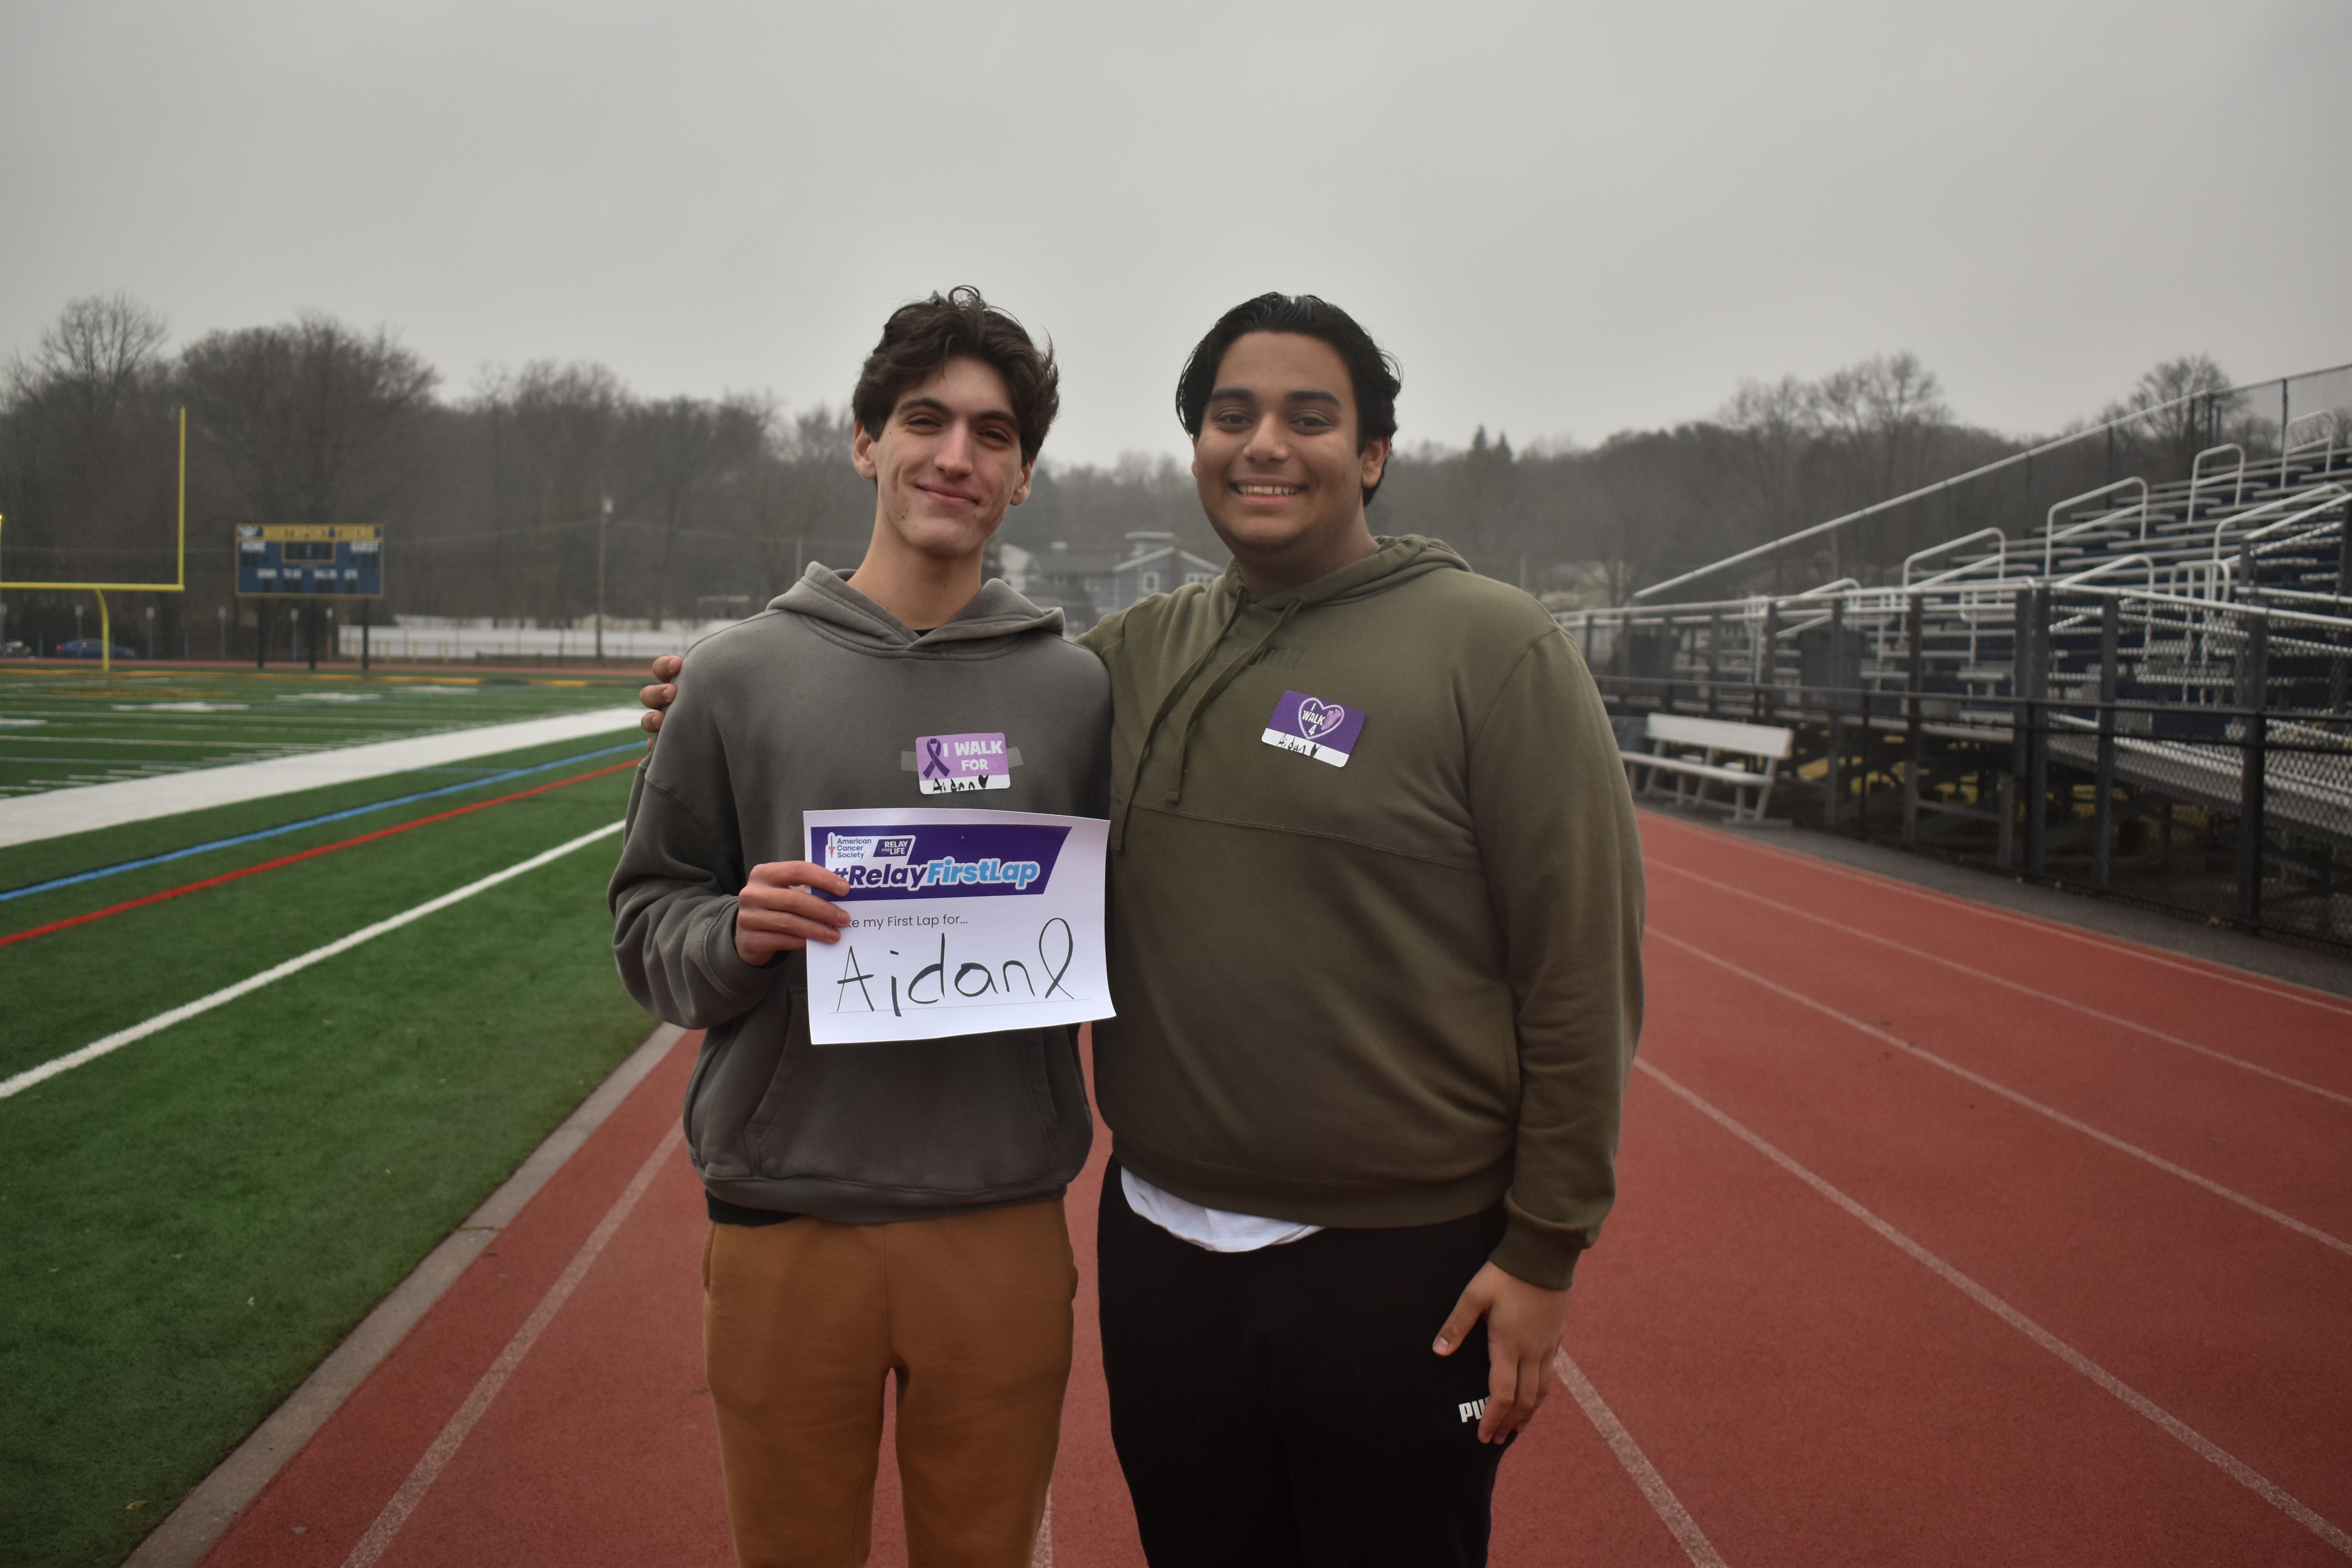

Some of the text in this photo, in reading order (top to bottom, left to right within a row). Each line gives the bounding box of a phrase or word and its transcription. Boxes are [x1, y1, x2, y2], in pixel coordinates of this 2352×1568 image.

[1302, 710, 1326, 725] WALK
[1308, 724, 1317, 735] 4
[943, 740, 1003, 757] I WALK
[1276, 732, 1306, 754] Aidan
[961, 759, 989, 771] FOR
[933, 777, 975, 792] Aidan
[834, 859, 1038, 887] #RelayFirstLap
[864, 919, 884, 930] my
[888, 916, 913, 926] First
[917, 916, 939, 928] Lap
[943, 914, 968, 924] for...
[837, 933, 1036, 1017] Aidan
